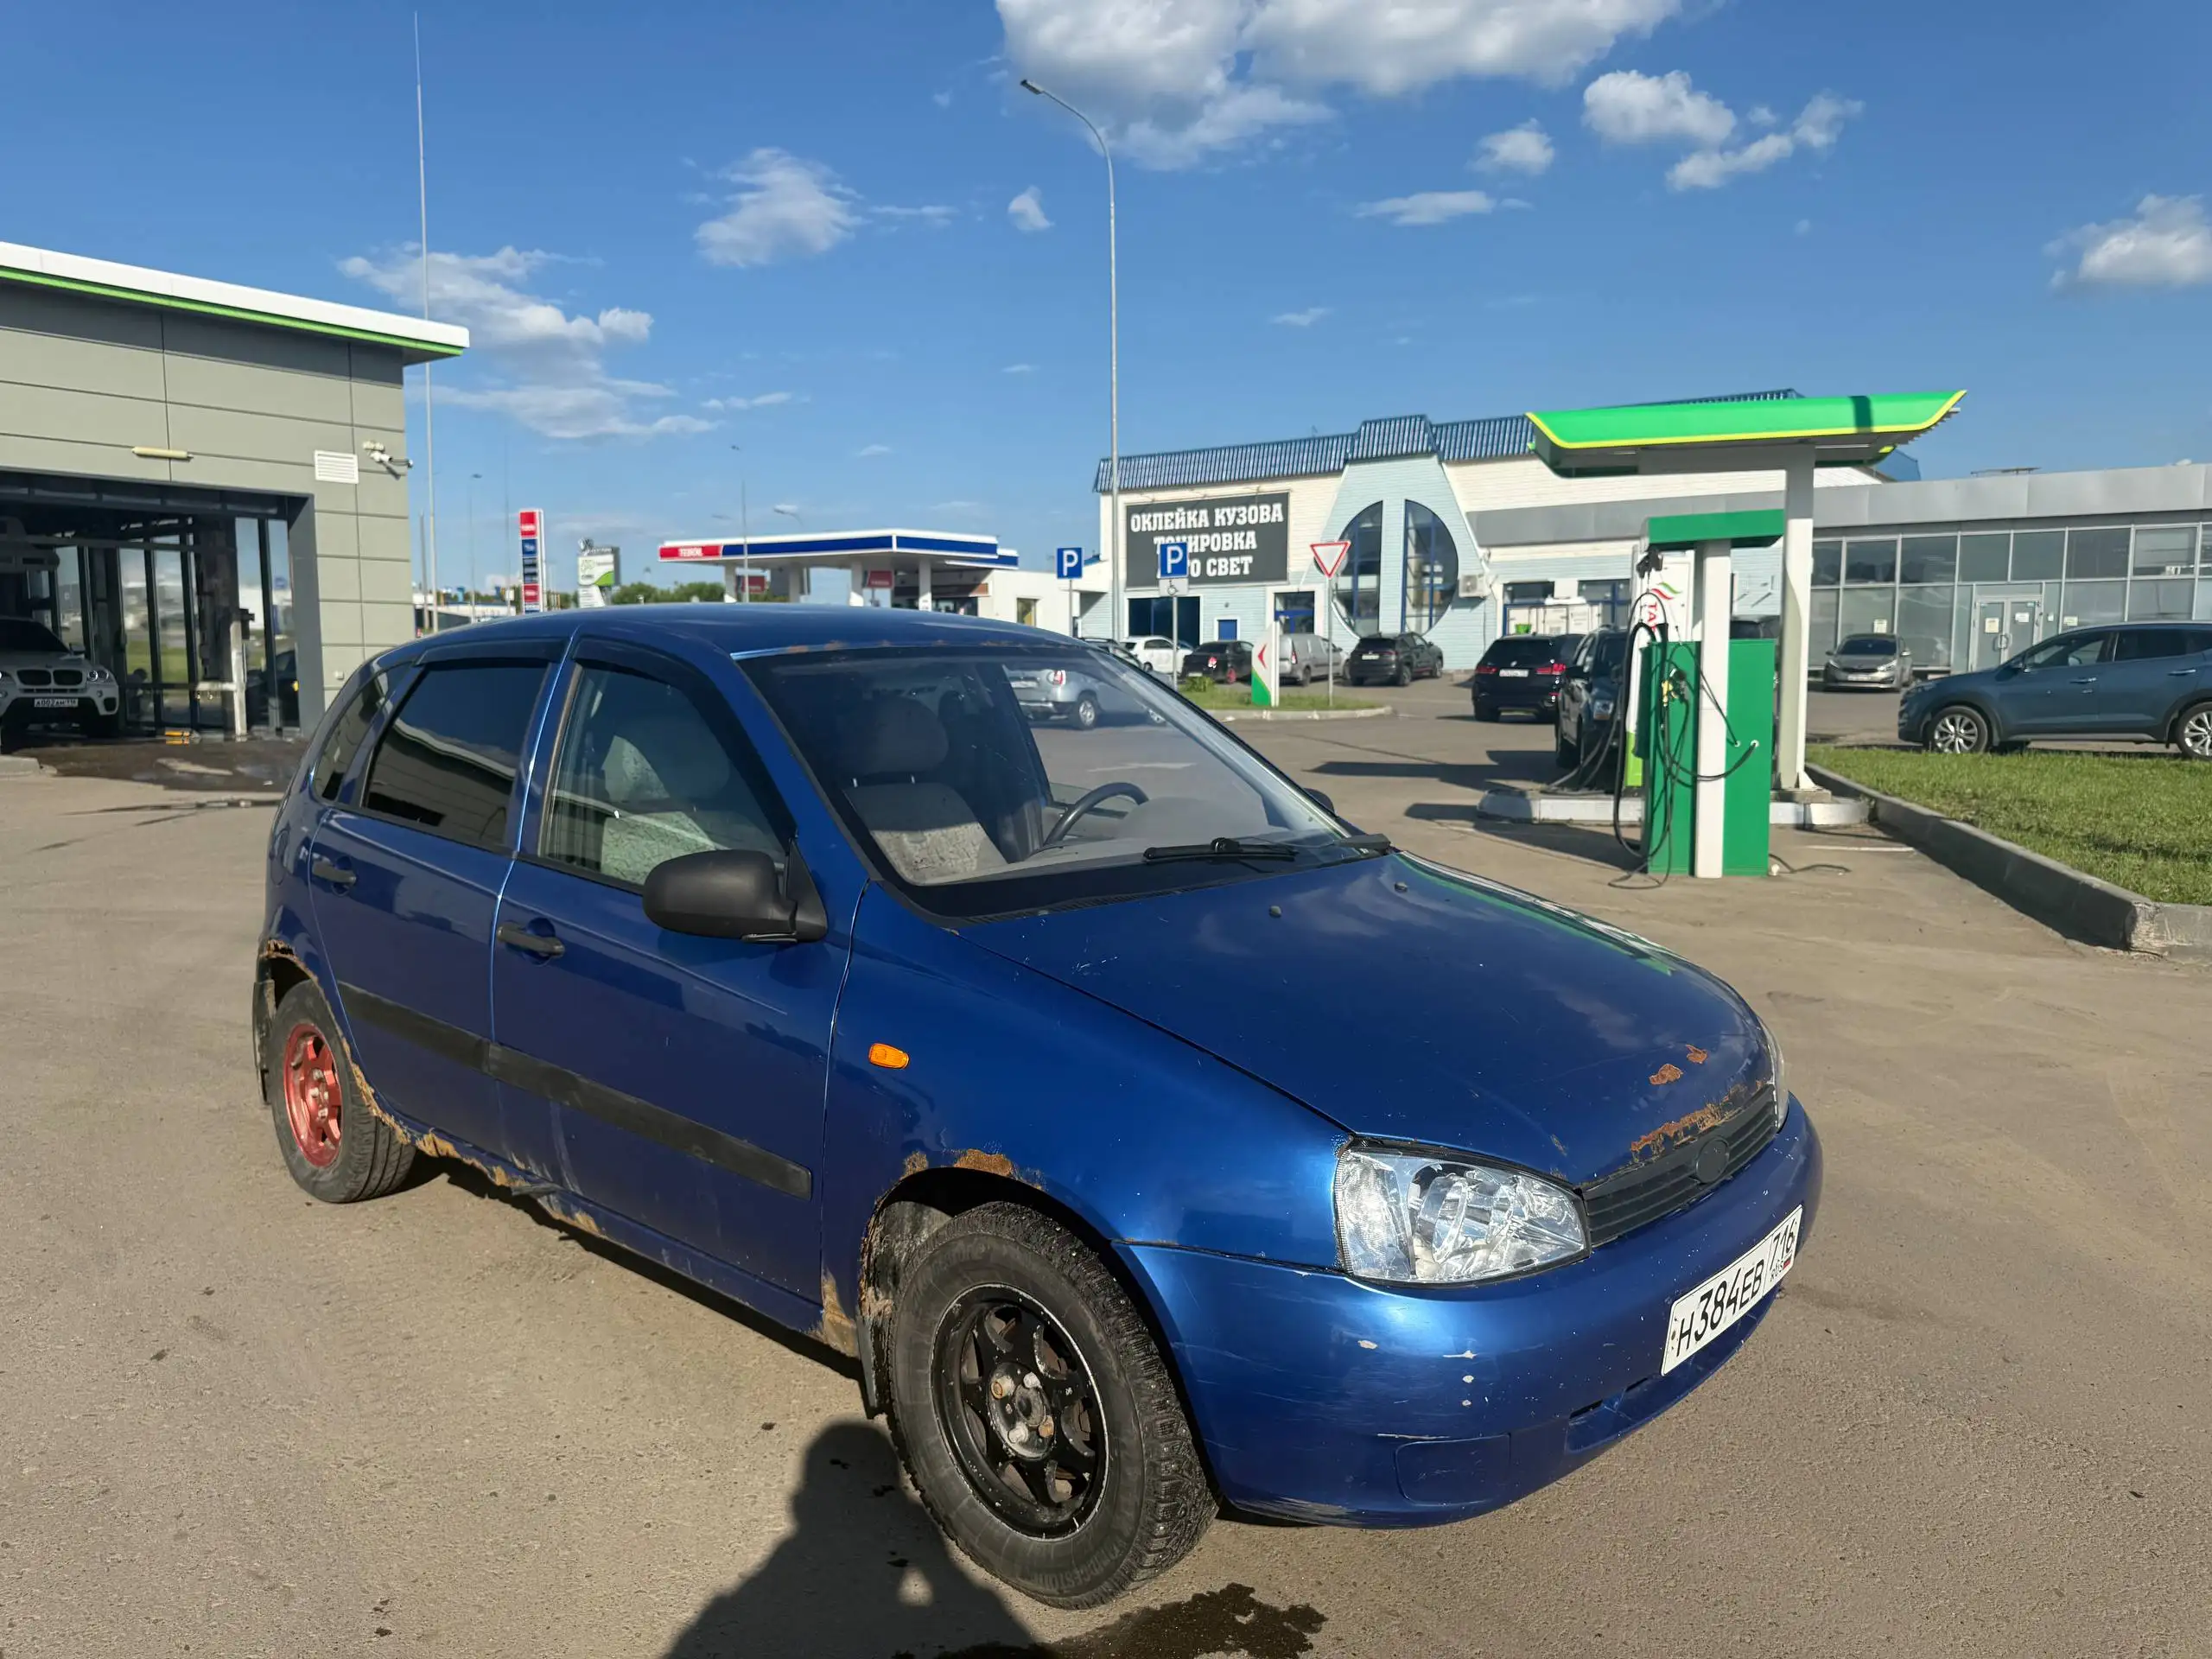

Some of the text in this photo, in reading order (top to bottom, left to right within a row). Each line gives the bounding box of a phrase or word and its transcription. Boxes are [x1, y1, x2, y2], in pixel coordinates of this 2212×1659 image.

[1130, 502, 1284, 532] ОКЛЕЙКА КУЗОВА
[1063, 550, 1078, 576] P
[1166, 546, 1183, 574] P
[1206, 556, 1253, 577] СВЕТ
[1770, 1219, 1796, 1270] 716
